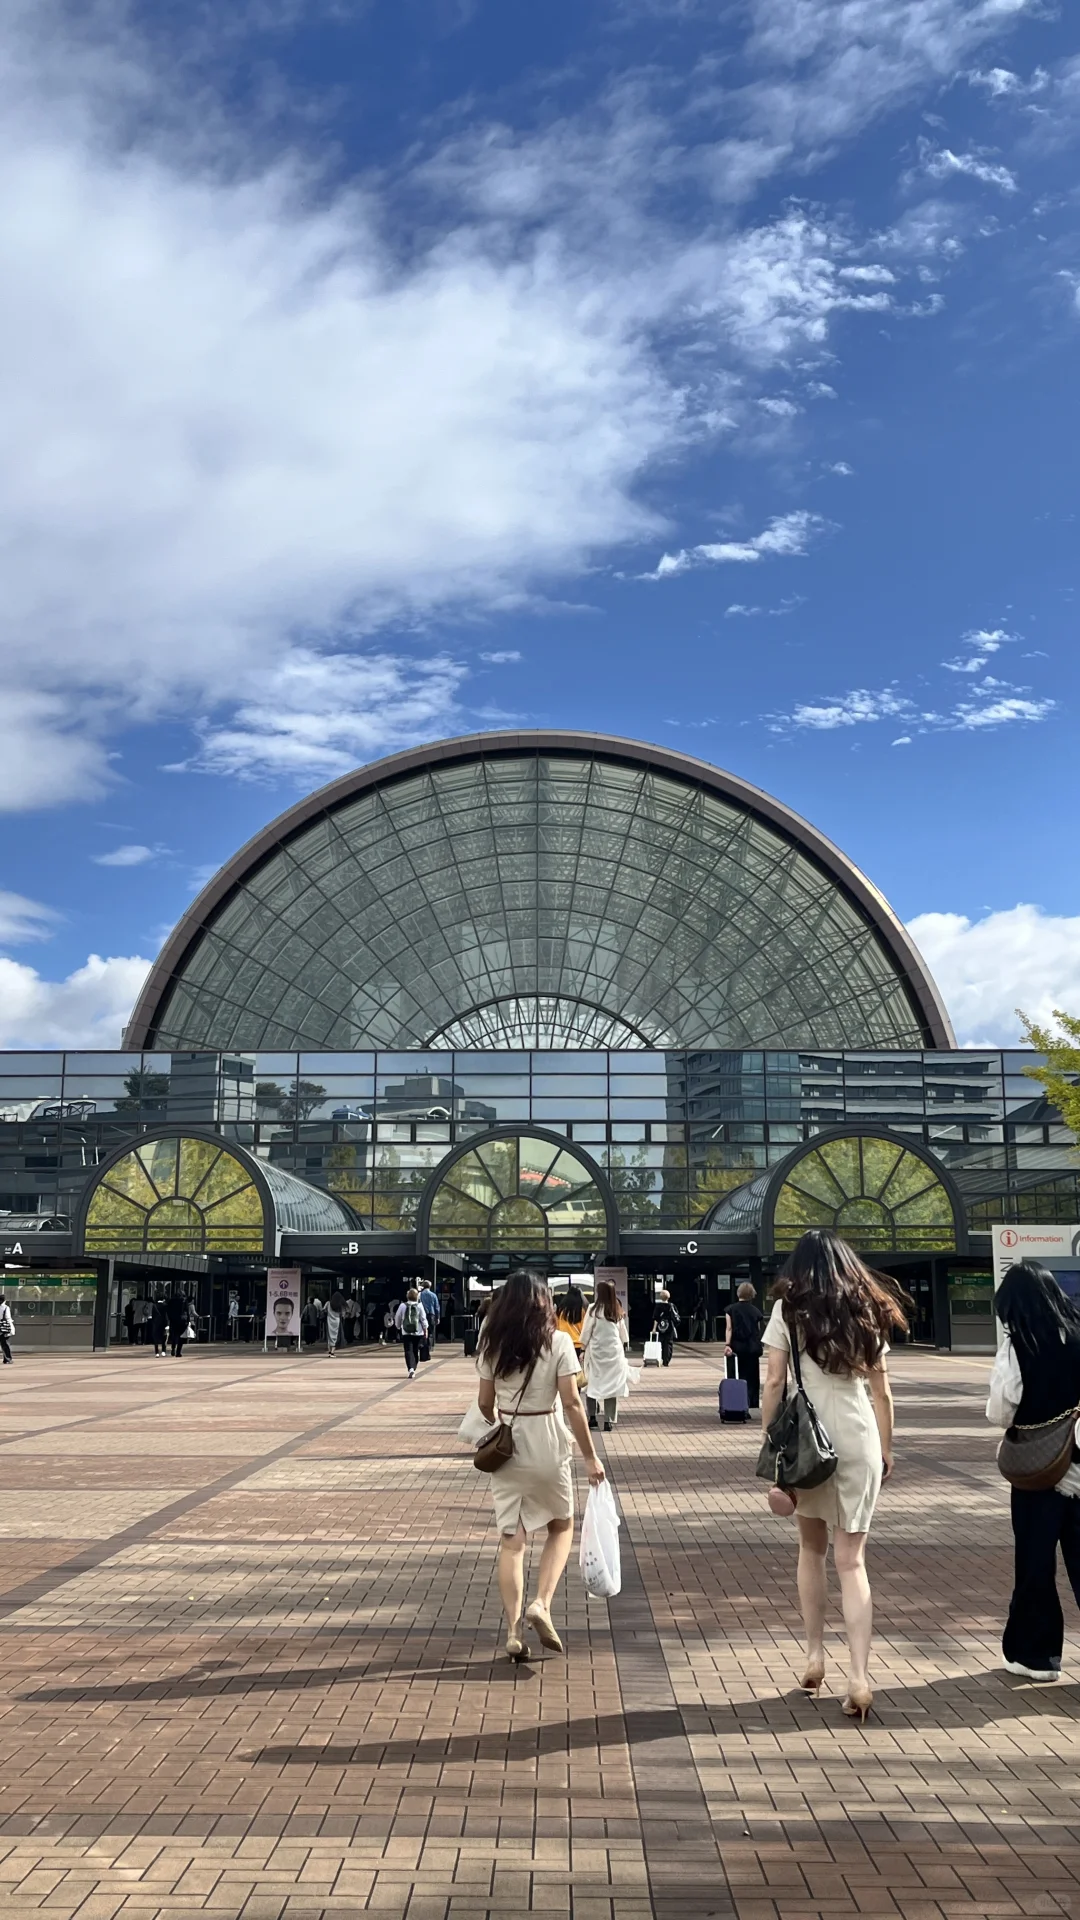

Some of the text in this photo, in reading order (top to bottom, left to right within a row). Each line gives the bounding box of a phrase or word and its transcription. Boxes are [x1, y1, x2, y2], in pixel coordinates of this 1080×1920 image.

[1019, 1235, 1064, 1243] Information
[12, 1242, 23, 1255] A
[348, 1241, 359, 1255] B
[687, 1240, 698, 1254] C
